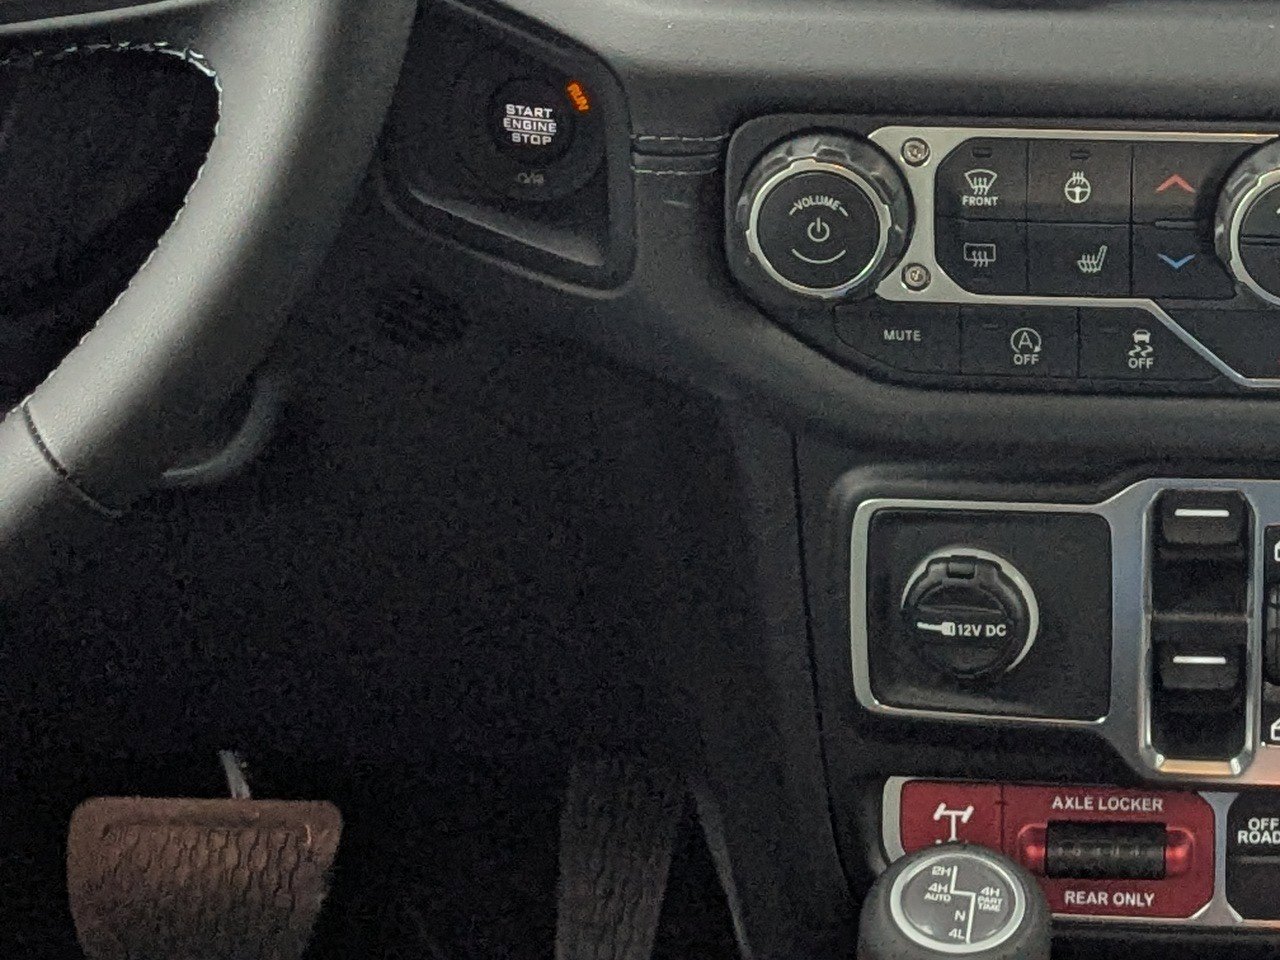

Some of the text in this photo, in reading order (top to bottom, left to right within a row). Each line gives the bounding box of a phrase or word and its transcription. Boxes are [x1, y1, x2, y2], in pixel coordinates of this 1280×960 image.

[505, 103, 553, 119] START
[503, 117, 557, 133] ENGINE
[511, 133, 552, 146] STOP
[793, 195, 840, 210] VOLUME
[962, 195, 998, 207] FRONT
[884, 329, 922, 342] MUTE
[1013, 353, 1039, 366] OFF
[1128, 356, 1154, 369] OFF
[957, 623, 1007, 638] 12V DC
[1052, 796, 1163, 813] AXLE LOCKER
[1248, 817, 1279, 831] OFF
[927, 882, 949, 894] 4H
[980, 886, 1000, 897] 4H
[924, 892, 952, 903] AUTO
[1064, 890, 1155, 907] REAR ONLY
[954, 909, 966, 922] N
[948, 927, 965, 940] 4L
